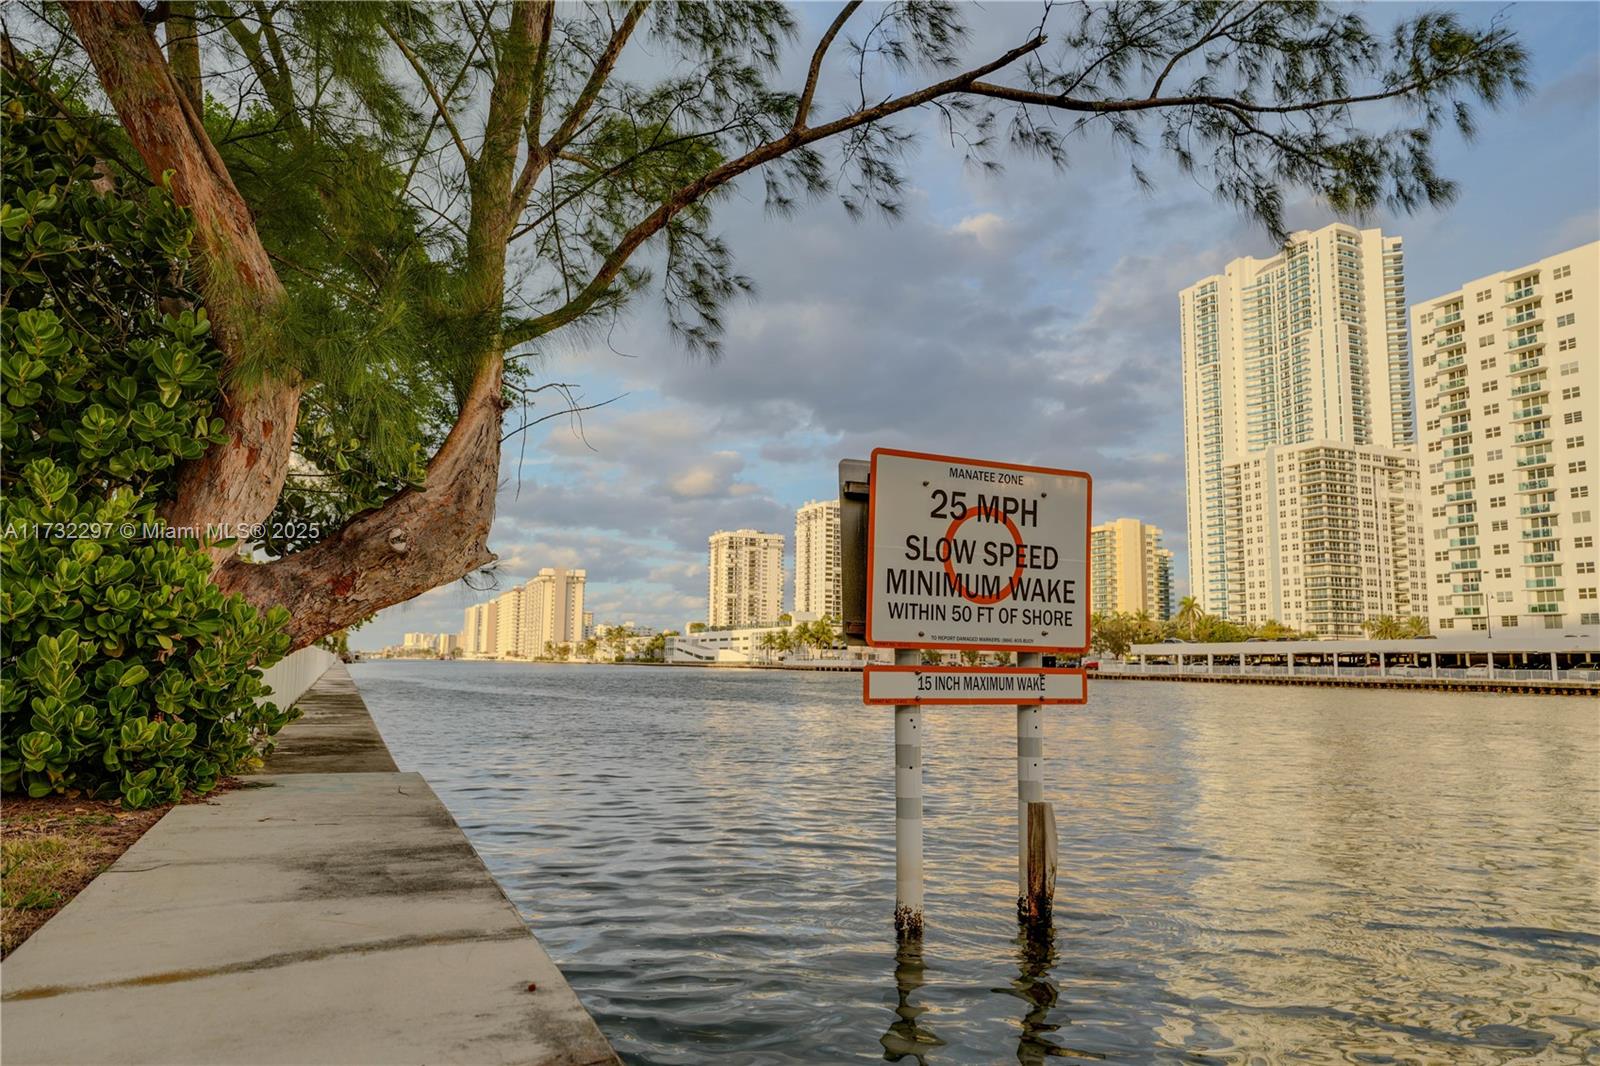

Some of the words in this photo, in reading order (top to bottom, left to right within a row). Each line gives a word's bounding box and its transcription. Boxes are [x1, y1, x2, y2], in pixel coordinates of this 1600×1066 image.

[949, 467, 996, 483] MANATEE
[998, 473, 1024, 486] ZONE
[930, 489, 968, 521] 25
[977, 494, 1038, 527] MPH
[905, 534, 976, 565] SLOW
[983, 541, 1059, 570] SPEED
[886, 568, 1000, 600] MINIMUM
[1009, 576, 1076, 604] WAKE
[888, 602, 946, 621] WITHIN
[951, 605, 972, 622] 50
[977, 606, 994, 623] FT
[999, 607, 1018, 625] OF
[1022, 609, 1073, 627] SHORE
[917, 676, 932, 691] 15
[935, 676, 959, 691] INCH
[963, 676, 1014, 691] MAXIMUM
[1017, 677, 1046, 691] WAKE
